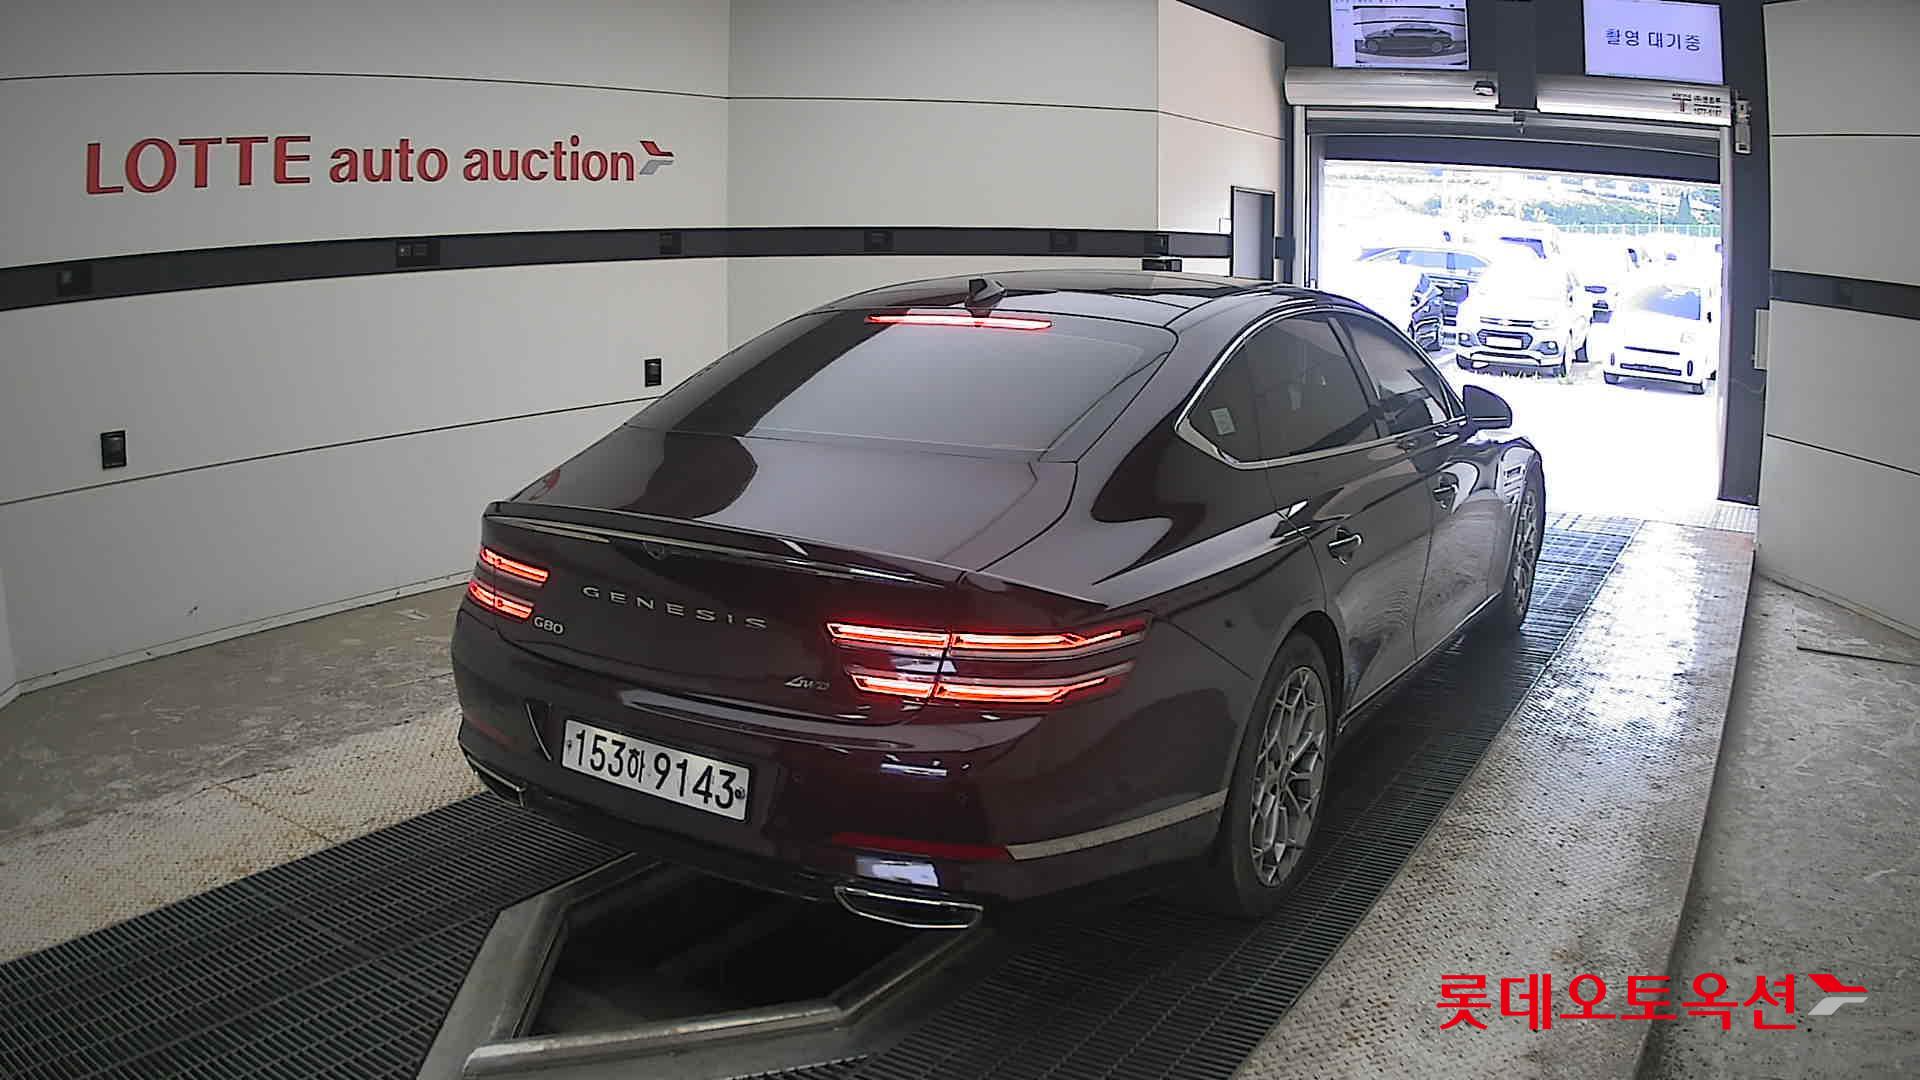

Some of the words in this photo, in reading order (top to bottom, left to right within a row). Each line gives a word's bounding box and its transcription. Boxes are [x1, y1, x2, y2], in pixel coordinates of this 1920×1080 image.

[87, 137, 311, 194] LOTTE
[330, 137, 448, 183] auto
[463, 135, 636, 182] auction
[533, 616, 565, 635] G80
[582, 586, 768, 630] GENESIS
[575, 729, 645, 783] 153하
[653, 752, 738, 809] 9143
